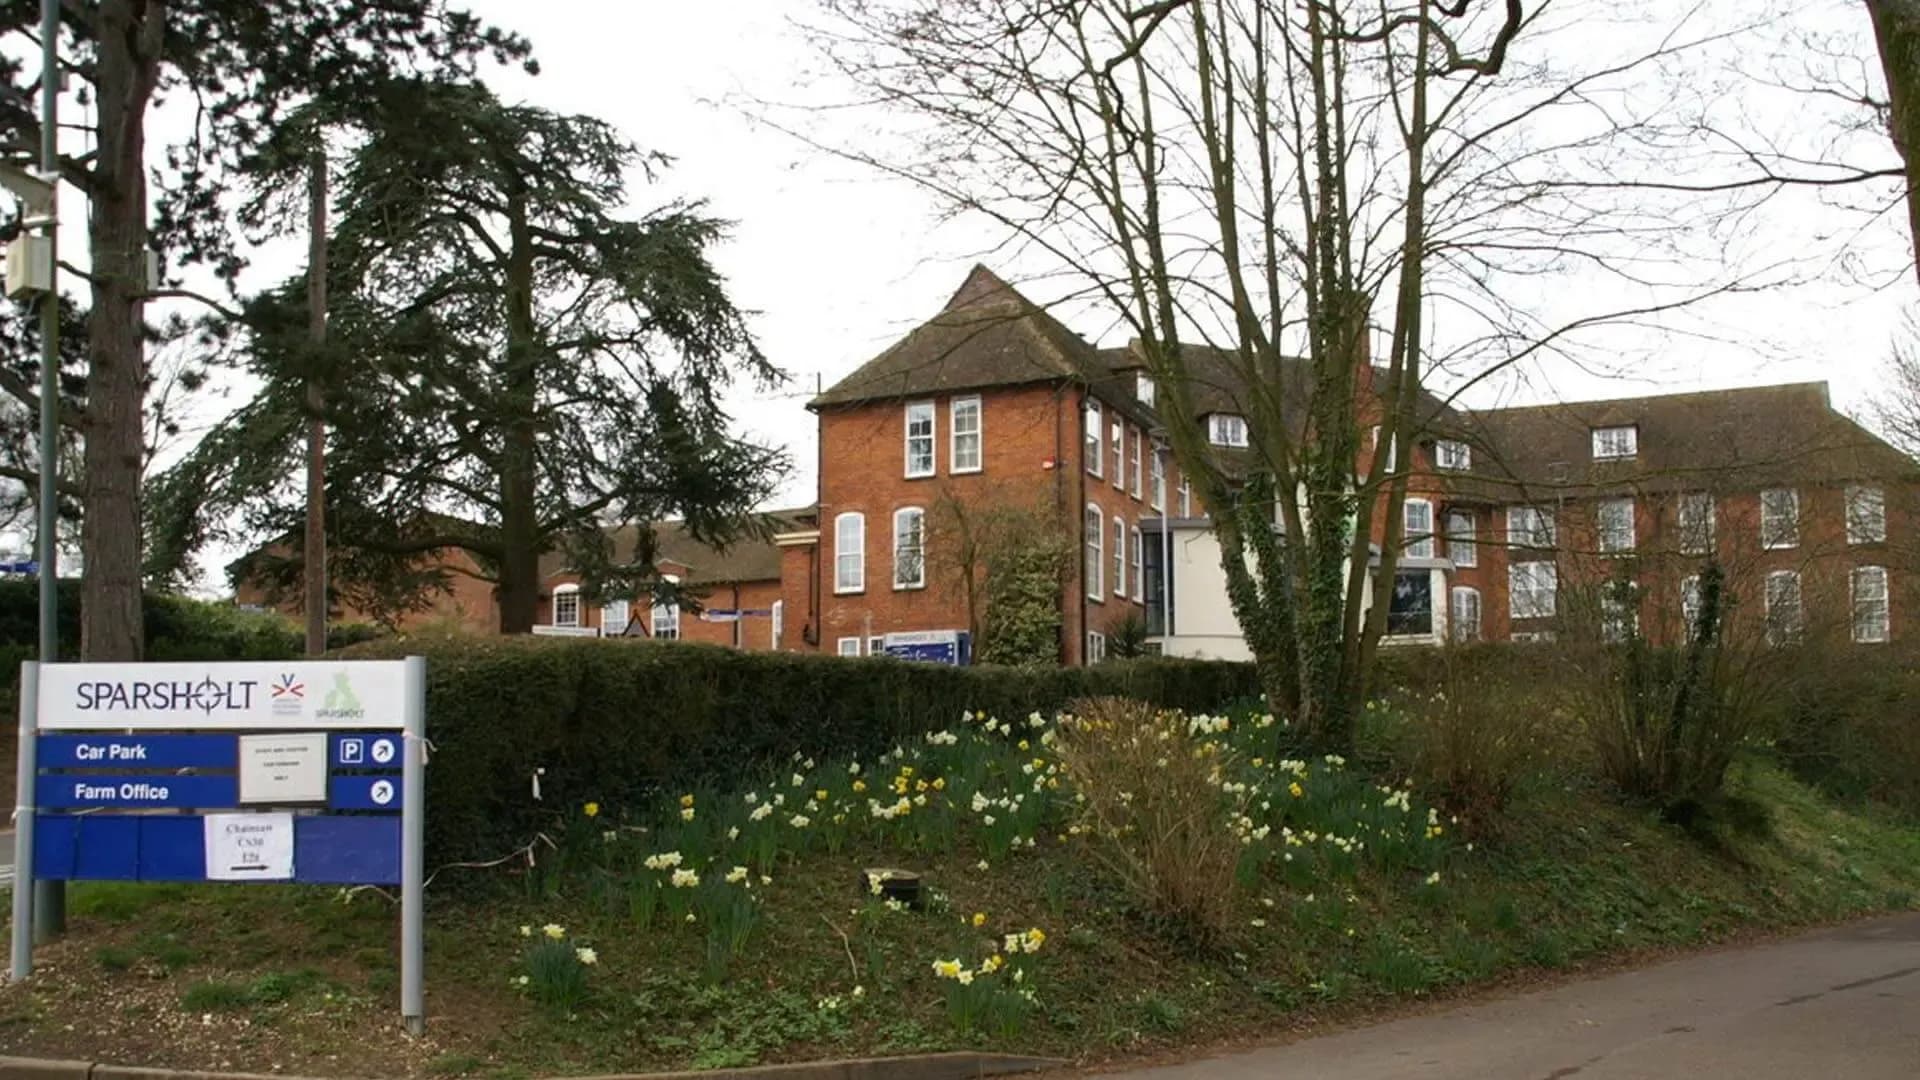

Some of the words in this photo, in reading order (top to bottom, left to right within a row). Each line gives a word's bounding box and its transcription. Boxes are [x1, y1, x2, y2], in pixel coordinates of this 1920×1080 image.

[76, 677, 258, 713] SPARSHOLT
[76, 743, 105, 760] Car
[109, 743, 146, 760] Park
[344, 742, 358, 760] P
[75, 783, 116, 800] Farm
[120, 783, 169, 800] Office
